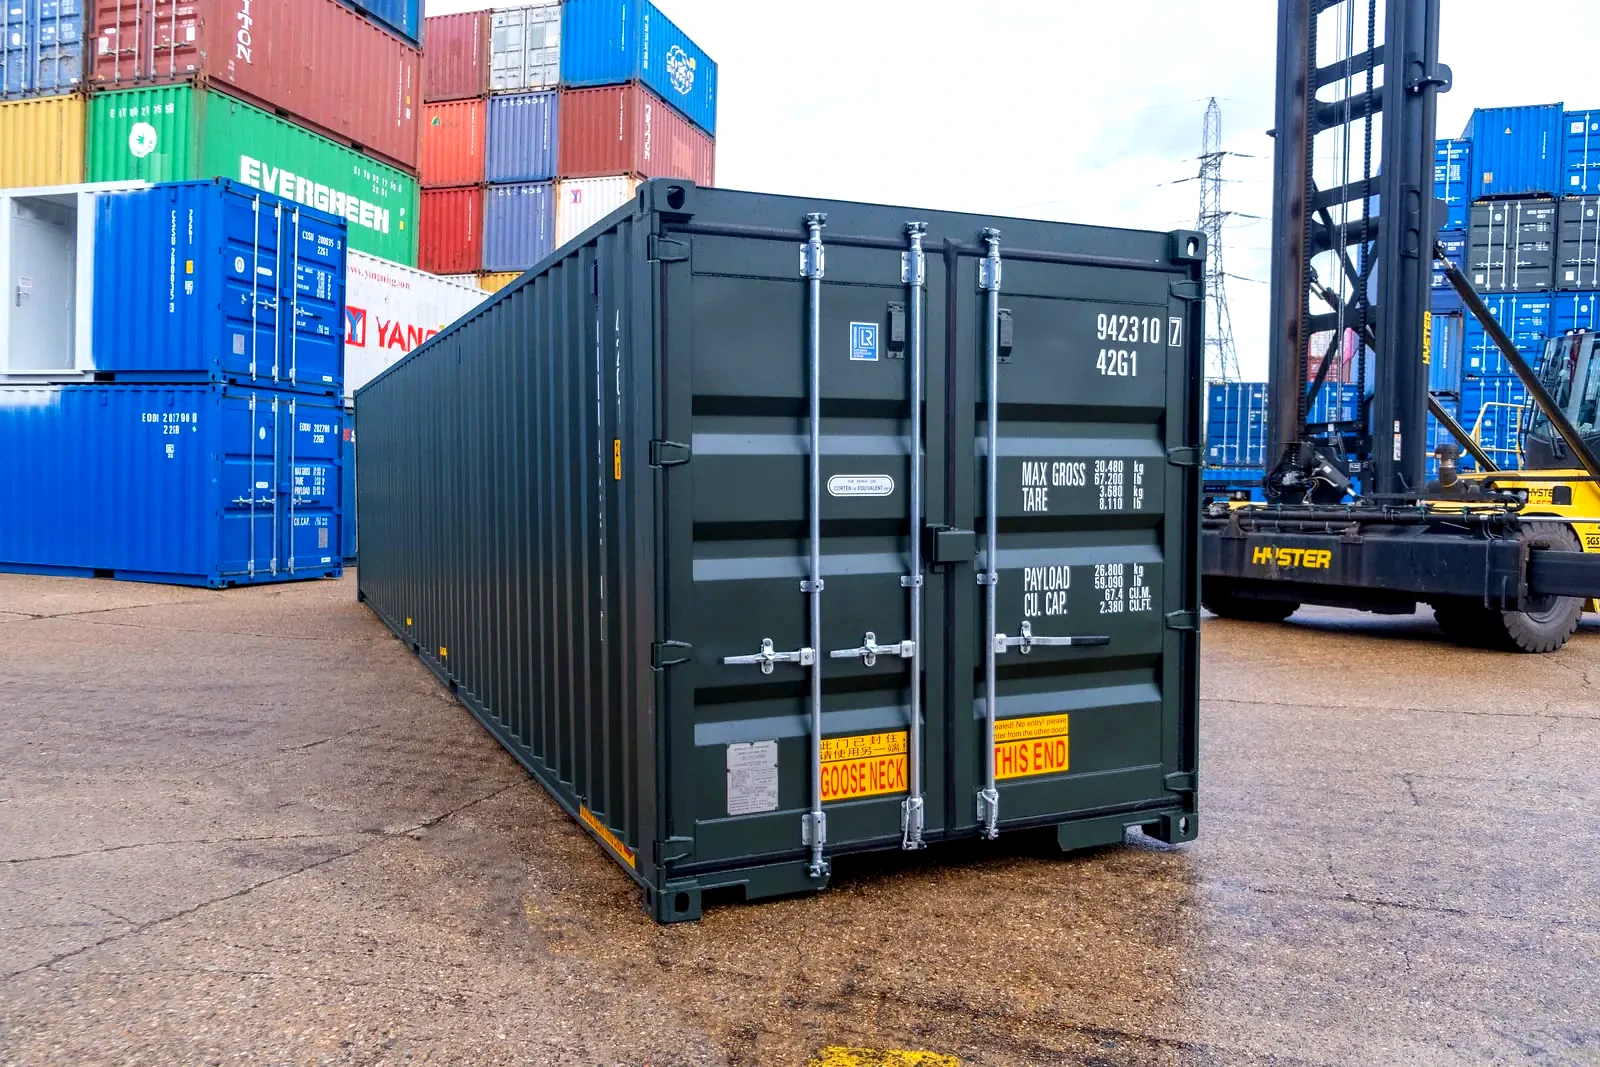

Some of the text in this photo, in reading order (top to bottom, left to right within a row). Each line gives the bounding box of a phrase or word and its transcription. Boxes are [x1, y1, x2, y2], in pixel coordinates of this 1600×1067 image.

[240, 154, 390, 234] EVERGREEN
[1097, 313, 1180, 345] 942310 7
[1096, 348, 1137, 377] 42G1
[1021, 460, 1144, 486] MAX GROSS 30.480 kg
[1094, 473, 1142, 485] 67.200 lb
[1022, 485, 1144, 512] TARE 3.680 kg
[1099, 498, 1141, 510] 8.110 lb
[1529, 488, 1553, 498] HYSTE
[1252, 546, 1332, 569] HYSTER
[1024, 562, 1144, 592] PAYLOAD 26.800 kg
[1094, 575, 1141, 589] 59.090 lb
[1024, 592, 1042, 617] CU.
[1045, 591, 1068, 616] CAP.
[1104, 588, 1123, 601] 67.4
[1099, 599, 1123, 614] 2.380
[993, 724, 1066, 740] nter from the other door!
[994, 717, 1067, 731] ealed! No entry! please
[995, 739, 1066, 776] THIS END
[821, 757, 905, 797] GOOSE NECK
